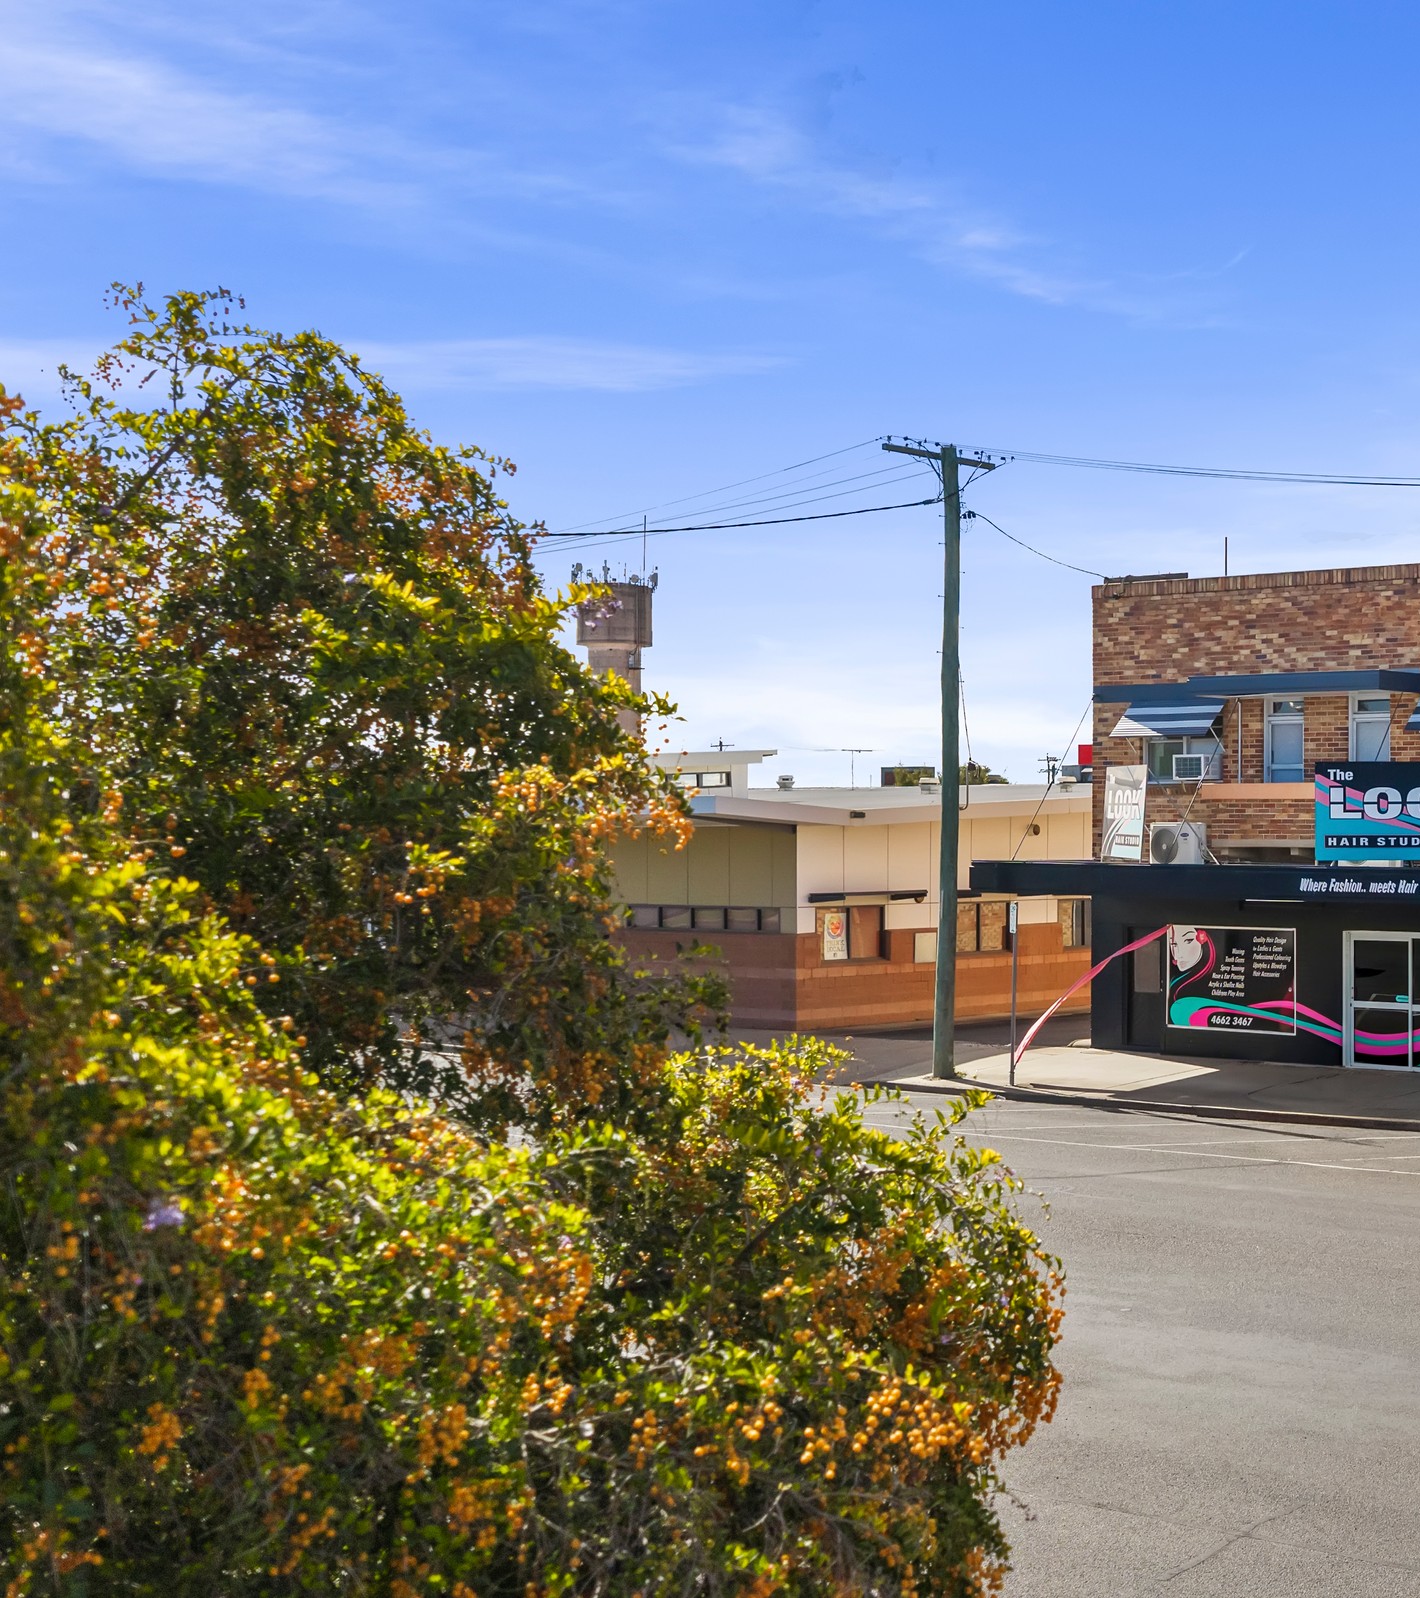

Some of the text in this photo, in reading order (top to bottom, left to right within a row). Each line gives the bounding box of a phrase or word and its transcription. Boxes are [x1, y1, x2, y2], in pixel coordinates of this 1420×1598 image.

[1328, 769, 1354, 781] The
[1107, 789, 1142, 819] LOOK
[1328, 837, 1369, 846] HAIR
[1300, 878, 1327, 892] Where
[1329, 878, 1366, 893] Fashion..
[1369, 880, 1396, 894] meets
[1398, 880, 1418, 894] Hair
[1253, 936, 1265, 944] Quality
[1274, 937, 1287, 945] Design
[1211, 1015, 1253, 1026] 4662 3467
